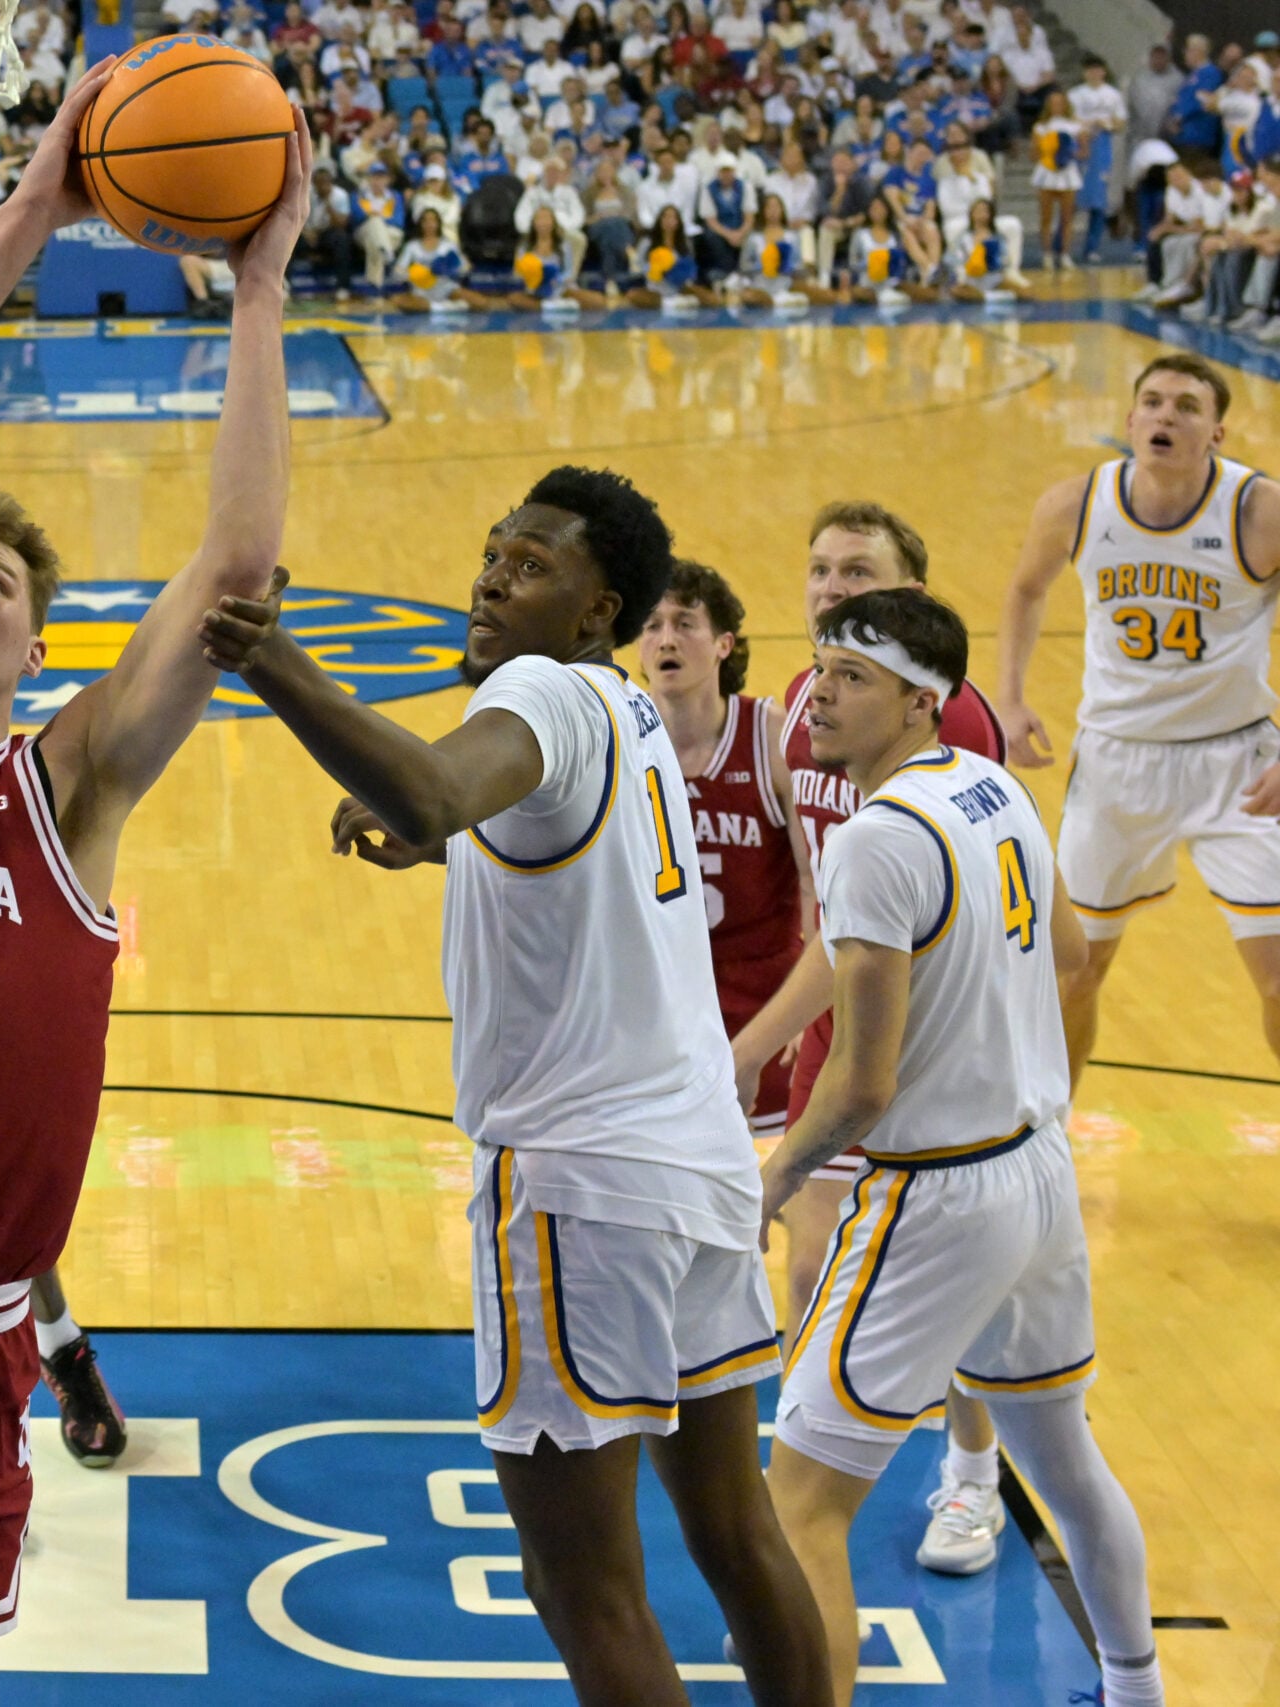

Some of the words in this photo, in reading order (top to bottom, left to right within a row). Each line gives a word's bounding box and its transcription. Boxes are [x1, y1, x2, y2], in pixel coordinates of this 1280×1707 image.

[1097, 562, 1220, 610] BRUINS
[1112, 606, 1207, 661] 34
[791, 768, 863, 817] NDIAN
[645, 765, 687, 904] 1
[997, 836, 1037, 954] 4
